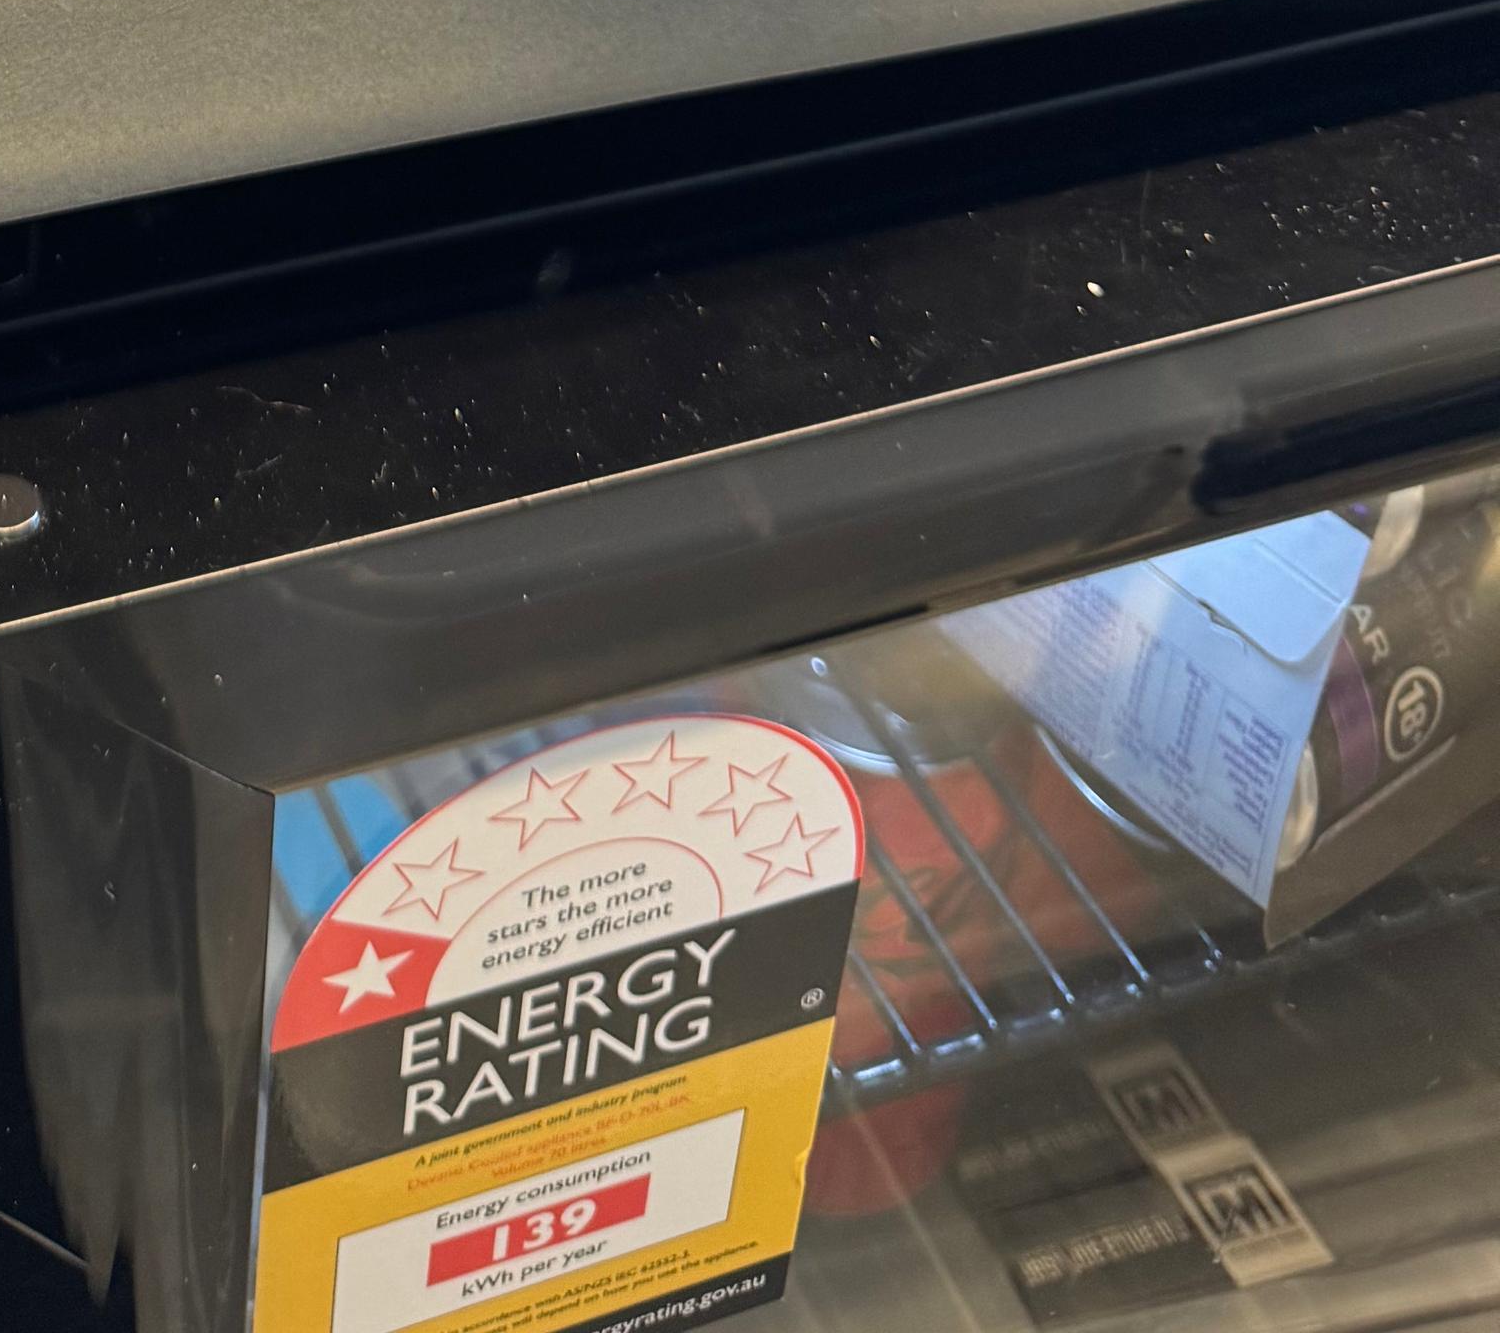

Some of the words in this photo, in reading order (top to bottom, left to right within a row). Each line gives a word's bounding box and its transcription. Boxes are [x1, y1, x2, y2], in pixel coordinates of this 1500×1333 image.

[487, 915, 547, 944] stars
[557, 900, 598, 924] the
[606, 879, 673, 910] more
[521, 884, 571, 909] The
[579, 861, 647, 893] more
[481, 933, 567, 970] energy
[575, 900, 674, 942] efficient
[399, 928, 737, 1079] ENERGY
[401, 995, 713, 1136] RATING
[414, 1154, 426, 1169] A
[428, 1146, 460, 1167] joint
[463, 1119, 543, 1155] government
[546, 1106, 574, 1126] and
[575, 1093, 629, 1117] industry
[631, 1075, 688, 1102] program
[436, 1196, 509, 1230] Energy
[515, 1150, 652, 1206] consumption
[492, 1198, 597, 1262] 139
[461, 1270, 514, 1298] kWh
[520, 1255, 558, 1282] per
[562, 1238, 608, 1269] year
